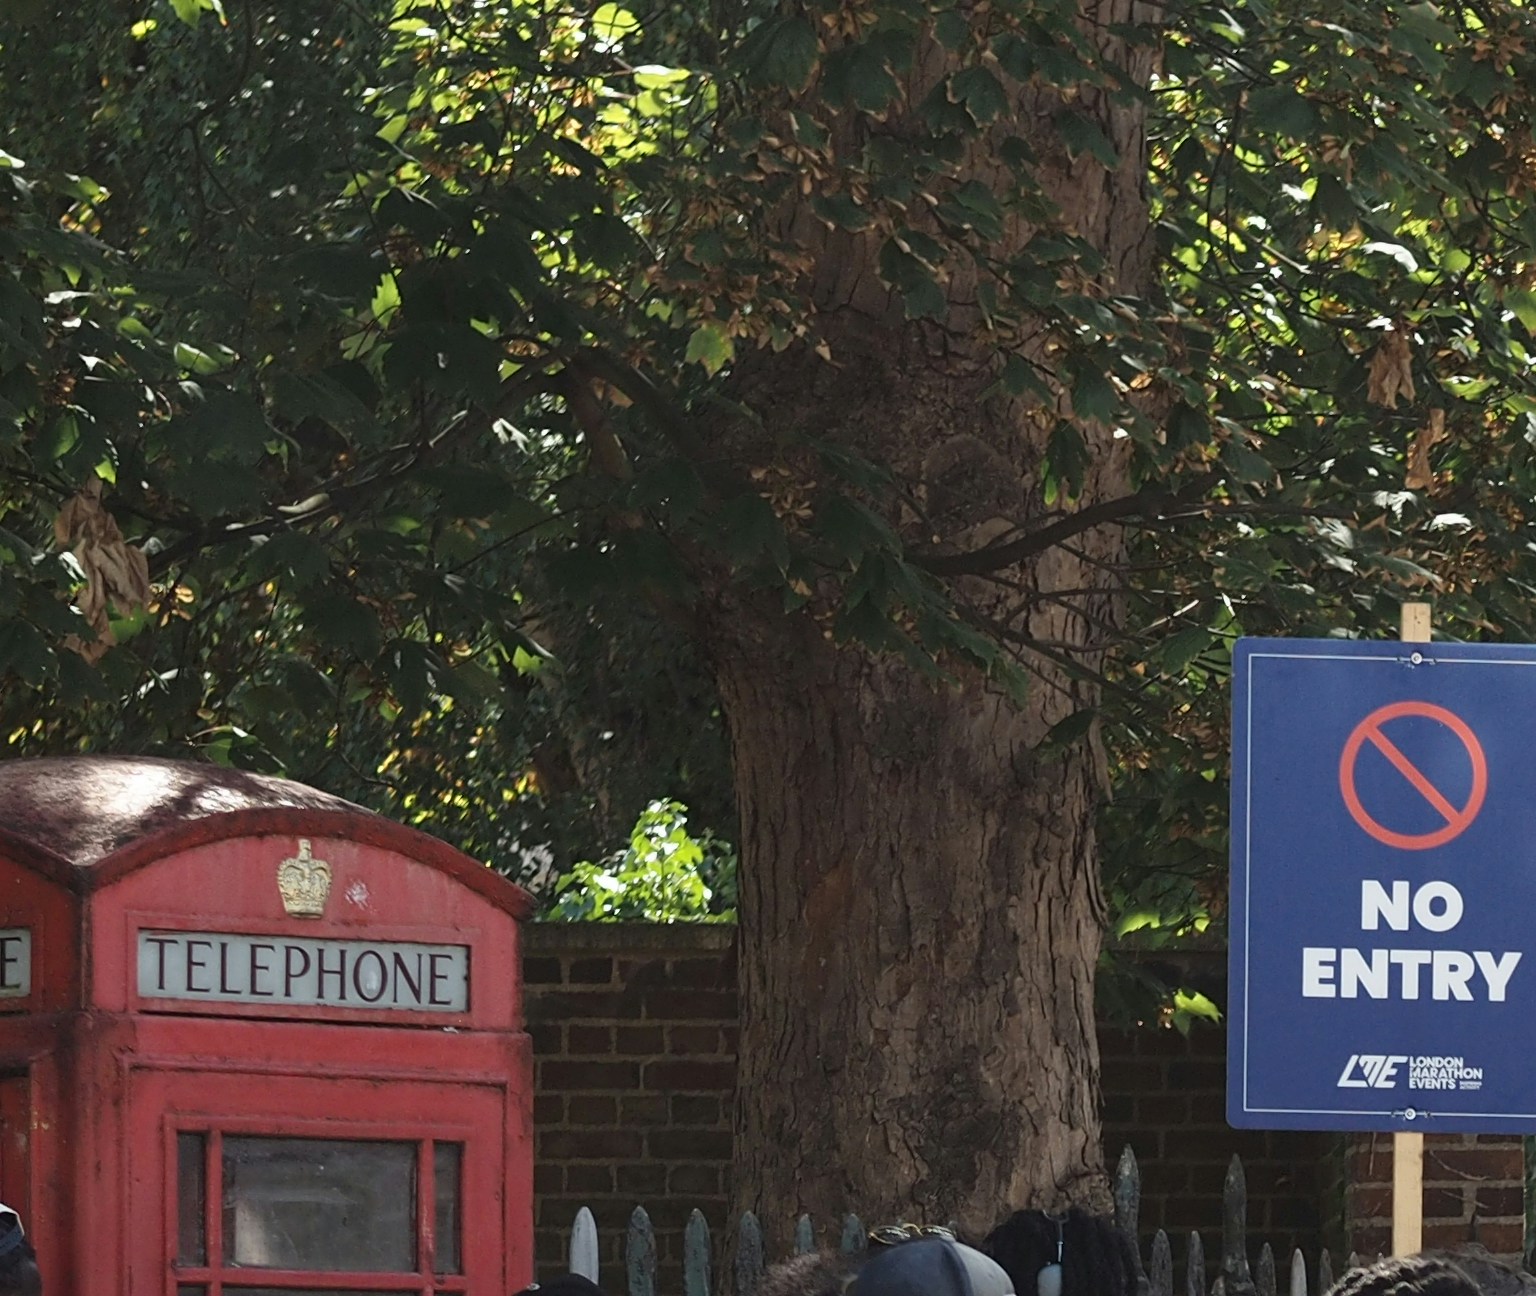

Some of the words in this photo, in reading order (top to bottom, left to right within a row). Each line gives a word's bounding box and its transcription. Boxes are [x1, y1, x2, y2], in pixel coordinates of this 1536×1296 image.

[1362, 880, 1463, 931] NO
[146, 938, 453, 1005] TELEPHONE
[1303, 948, 1522, 1001] ENTRY
[1409, 1056, 1463, 1068] LONDON
[1409, 1067, 1482, 1079] MARATHON
[1409, 1079, 1456, 1089] EVENTS
